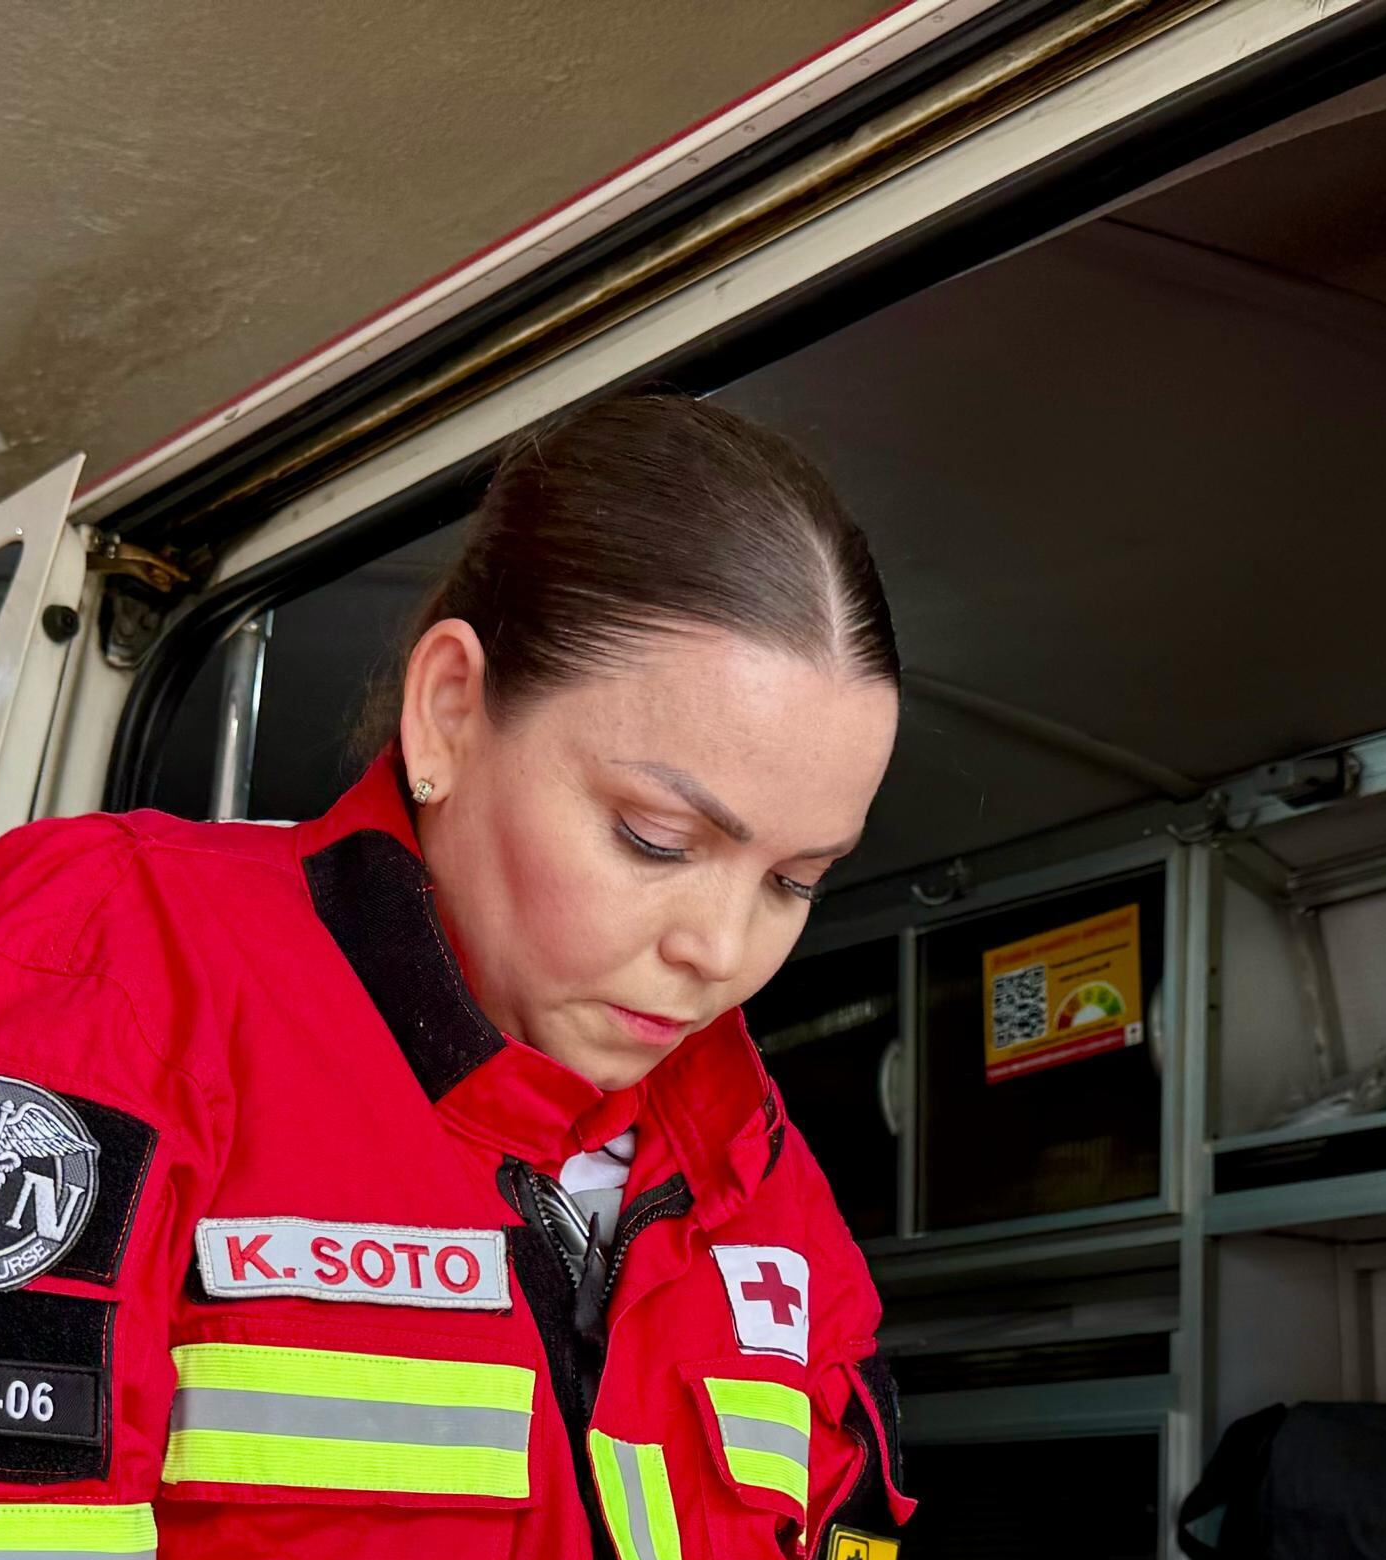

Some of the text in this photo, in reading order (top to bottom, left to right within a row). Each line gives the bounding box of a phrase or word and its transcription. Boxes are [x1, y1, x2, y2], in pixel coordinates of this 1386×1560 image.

[6, 1169, 85, 1242] N
[225, 1234, 481, 1294] K. SOTO
